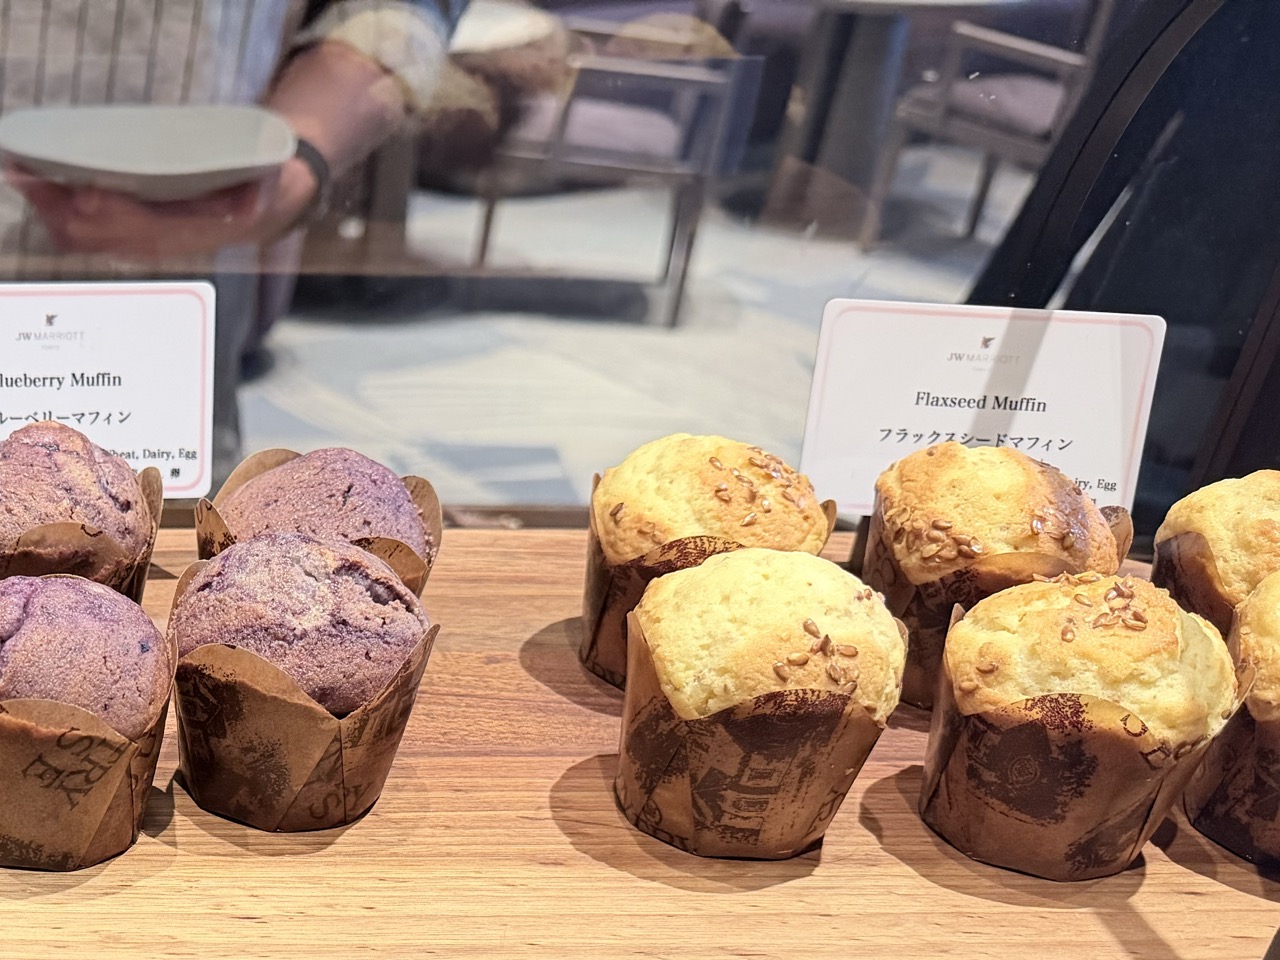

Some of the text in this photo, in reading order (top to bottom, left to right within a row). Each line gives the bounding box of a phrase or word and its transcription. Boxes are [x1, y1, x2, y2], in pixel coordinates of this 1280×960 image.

[16, 331, 86, 341] JW MARRIOTT
[947, 352, 965, 361] JW
[70, 372, 122, 387] Muffin
[914, 391, 1047, 413] Flaxseed Muffin
[879, 428, 1074, 451] フラックスシードマフィン
[109, 448, 197, 461] heat, Dairy, Egg
[1096, 478, 1117, 492] Egg
